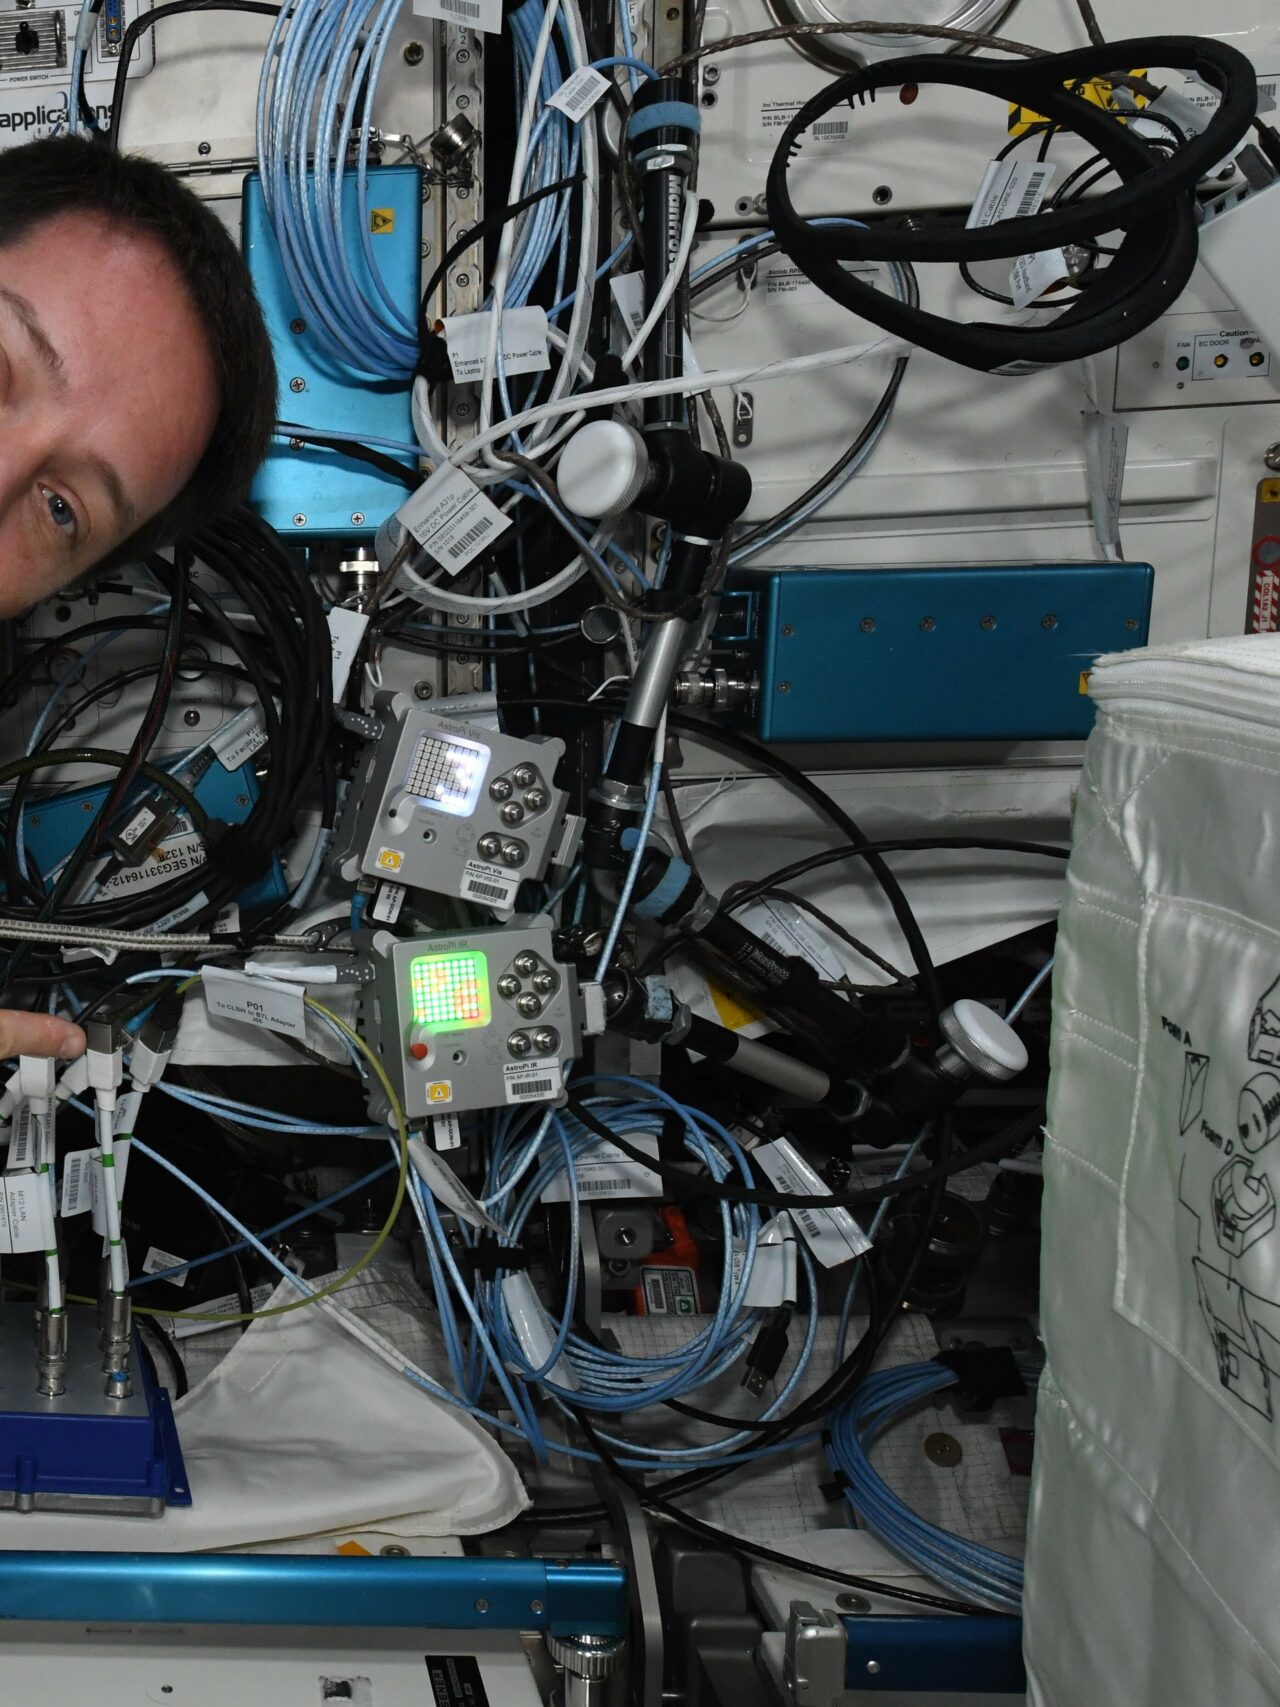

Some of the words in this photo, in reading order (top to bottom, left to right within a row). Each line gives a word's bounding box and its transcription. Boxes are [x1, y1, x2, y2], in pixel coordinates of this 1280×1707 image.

[8, 75, 29, 83] POWER
[985, 194, 999, 217] Cable
[1219, 329, 1249, 337] Caution
[454, 358, 479, 367] Enhanced
[512, 351, 528, 359] Power
[464, 367, 481, 376] Laptop
[413, 506, 441, 533] Enhanced
[439, 494, 455, 510] A31p
[419, 528, 431, 539] 16V
[431, 518, 441, 530] DC
[439, 502, 458, 521] Power
[456, 487, 474, 503] Cable
[428, 539, 439, 549] P/N
[433, 545, 444, 555] S/N
[438, 720, 466, 736] AstroPi
[468, 729, 480, 739] Vis
[227, 752, 236, 762] To
[235, 739, 256, 756] Facility
[249, 741, 262, 753] LAN
[187, 841, 206, 855] S/N
[190, 855, 208, 866] P/N
[468, 861, 492, 872] AstroPi
[492, 868, 502, 876] Vis
[427, 941, 456, 952] AstroPi
[246, 1001, 264, 1011] P01
[216, 1001, 226, 1009] To
[226, 1004, 247, 1014] CLSW
[255, 1011, 269, 1020] BTL
[270, 1016, 296, 1028] Adapter
[1183, 1031, 1192, 1047] A
[505, 1064, 530, 1072] AstroPi
[1223, 1139, 1234, 1156] D
[17, 1190, 26, 1204] M12
[9, 1192, 17, 1217] Adapter
[19, 1207, 27, 1222] LAN
